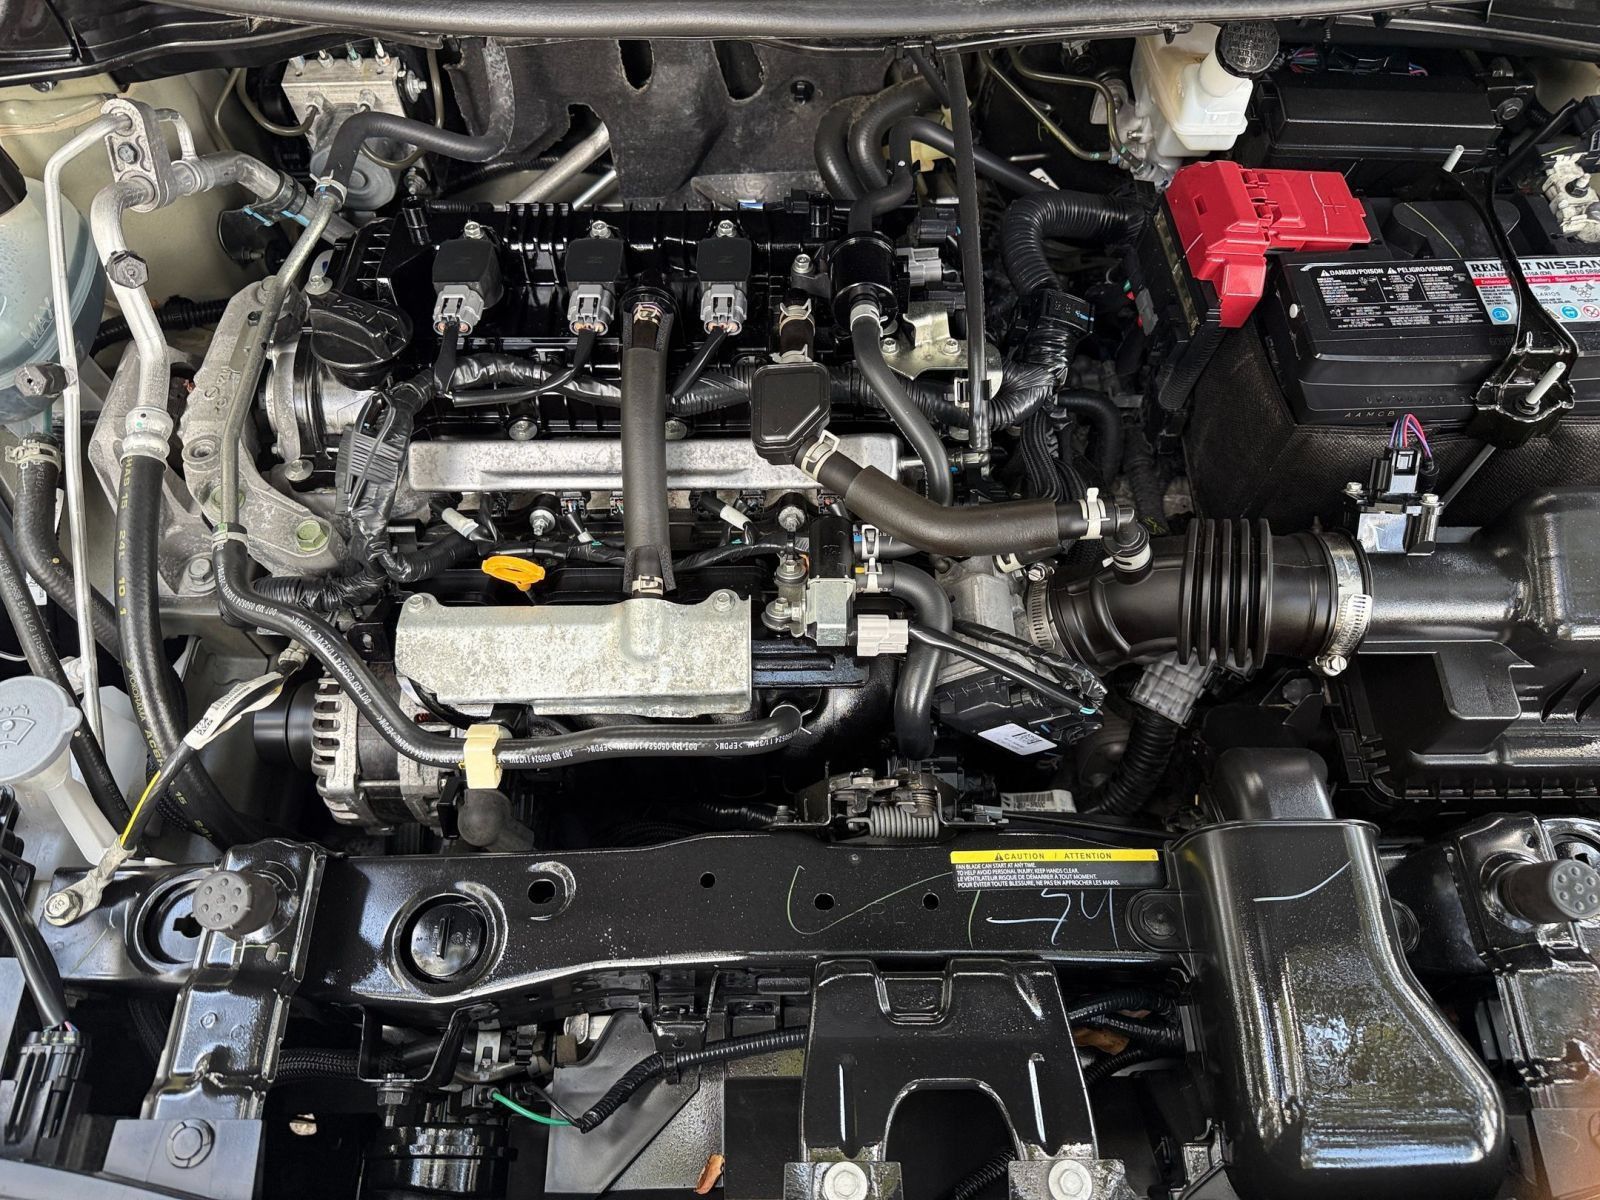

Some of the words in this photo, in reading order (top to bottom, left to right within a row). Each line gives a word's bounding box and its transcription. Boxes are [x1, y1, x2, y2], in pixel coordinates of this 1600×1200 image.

[1397, 265, 1453, 273] PELIGRO/VENENO
[1470, 262, 1532, 272] RENT
[1535, 260, 1600, 270] NISSAN
[1329, 268, 1384, 276] DANGER/POISON
[129, 673, 146, 722] YOKOHAMA
[1004, 852, 1045, 860] CAUTION
[1064, 852, 1112, 860] ATTENTION
